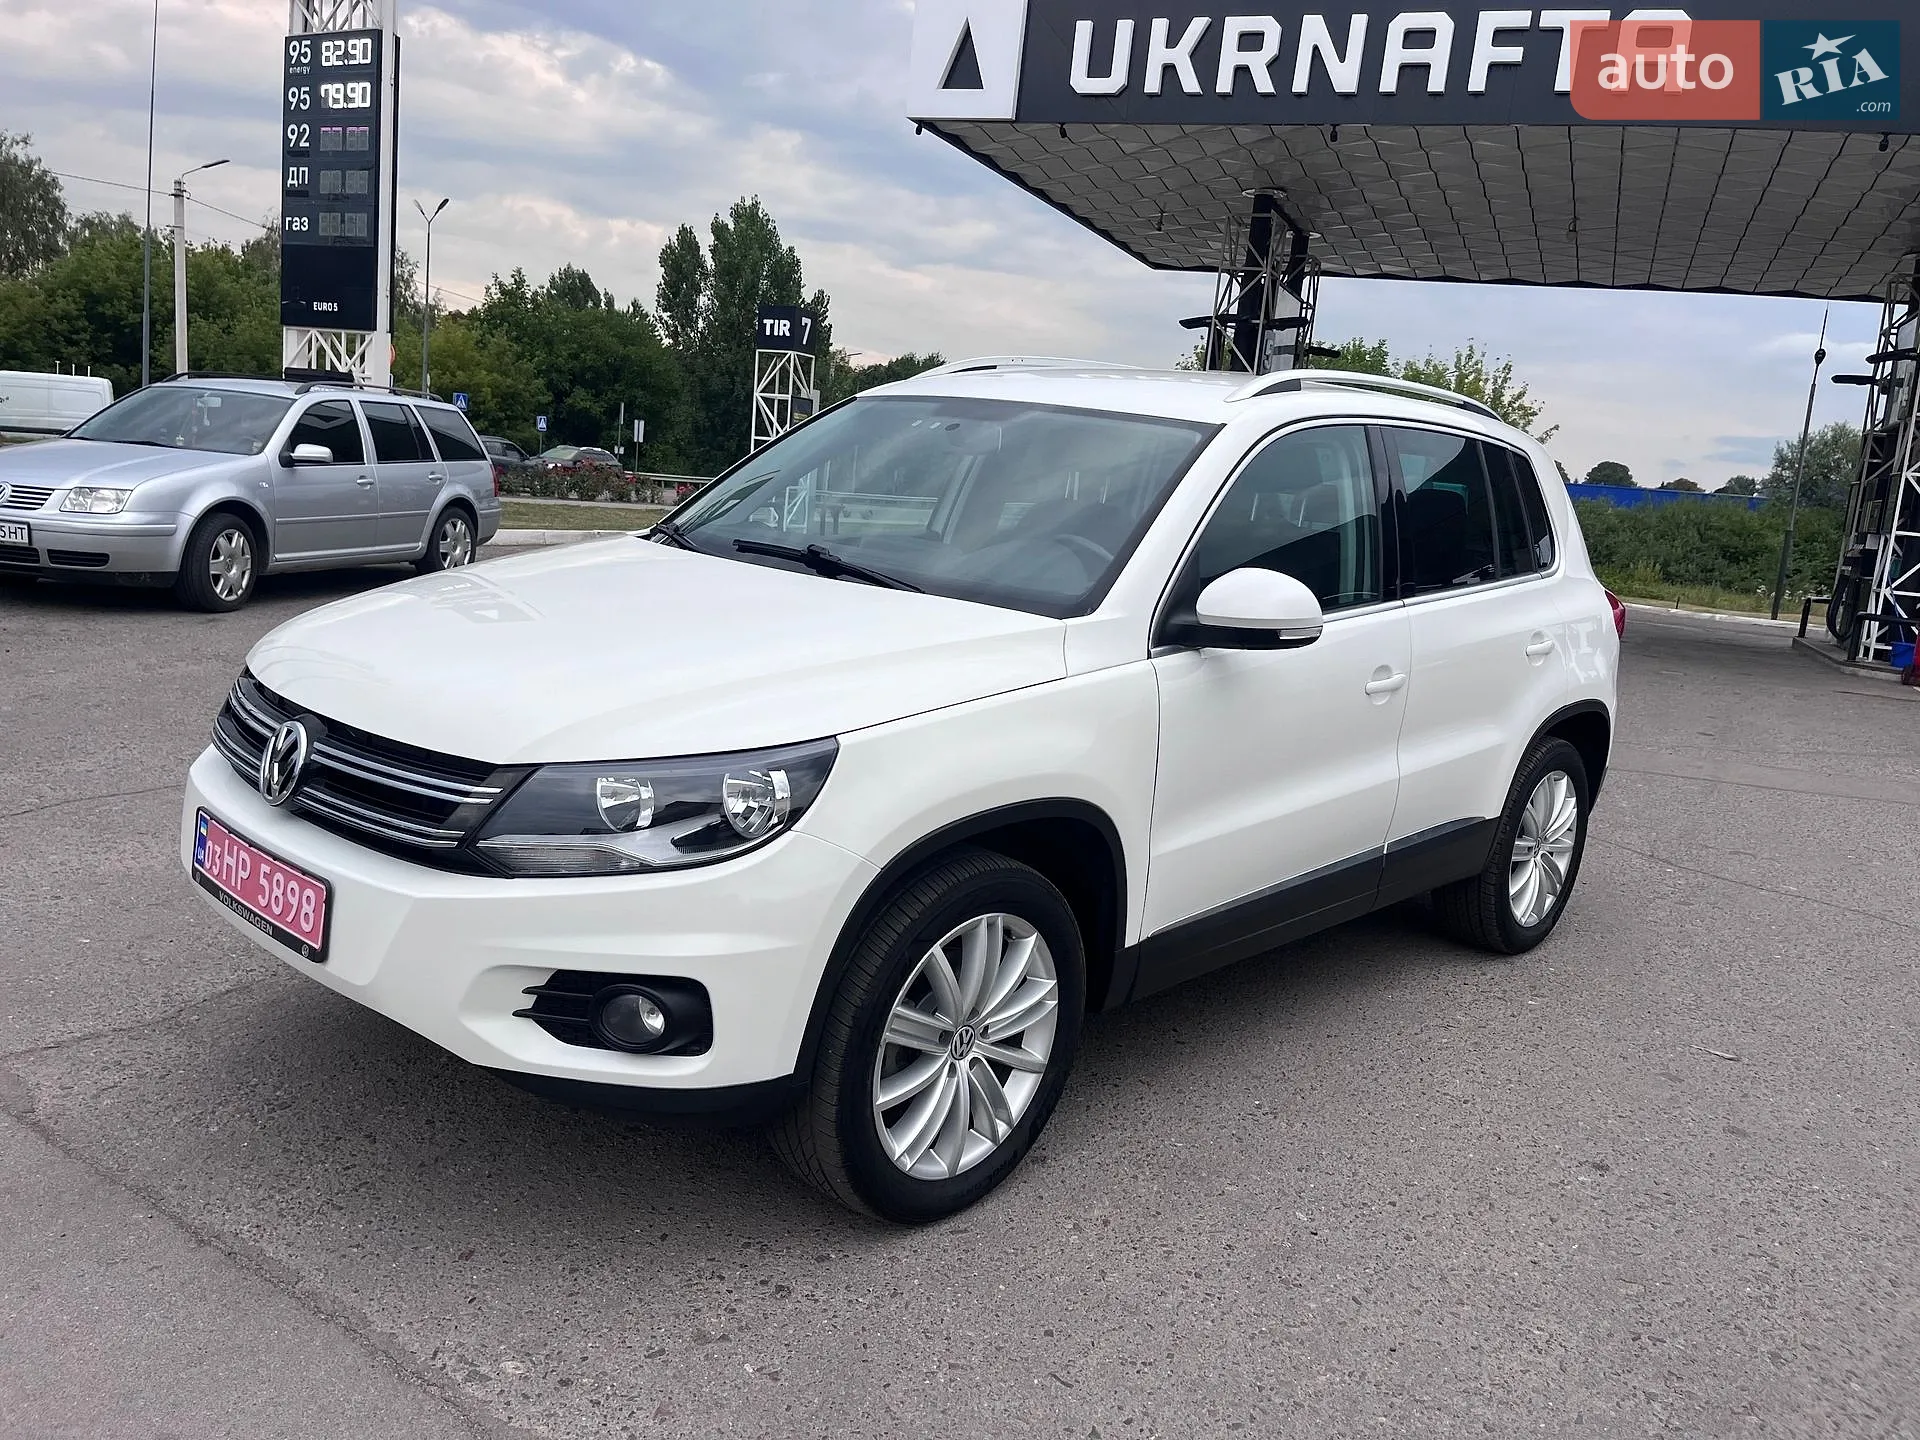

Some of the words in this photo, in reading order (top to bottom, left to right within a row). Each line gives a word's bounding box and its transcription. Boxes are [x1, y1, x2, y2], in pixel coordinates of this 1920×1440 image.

[289, 40, 311, 64] 95
[322, 39, 371, 66] 82.90
[1071, 8, 1693, 96] UKRNAFTA
[289, 66, 311, 75] energy
[288, 87, 310, 110] 95
[321, 83, 371, 108] 79.90
[287, 123, 310, 148] 92
[287, 167, 308, 187] ДП
[285, 216, 309, 231] газ
[763, 319, 790, 336] TIR
[801, 317, 811, 345] 7
[257, 862, 316, 933] 5898
[218, 889, 274, 936] VOLKSWAGEN
